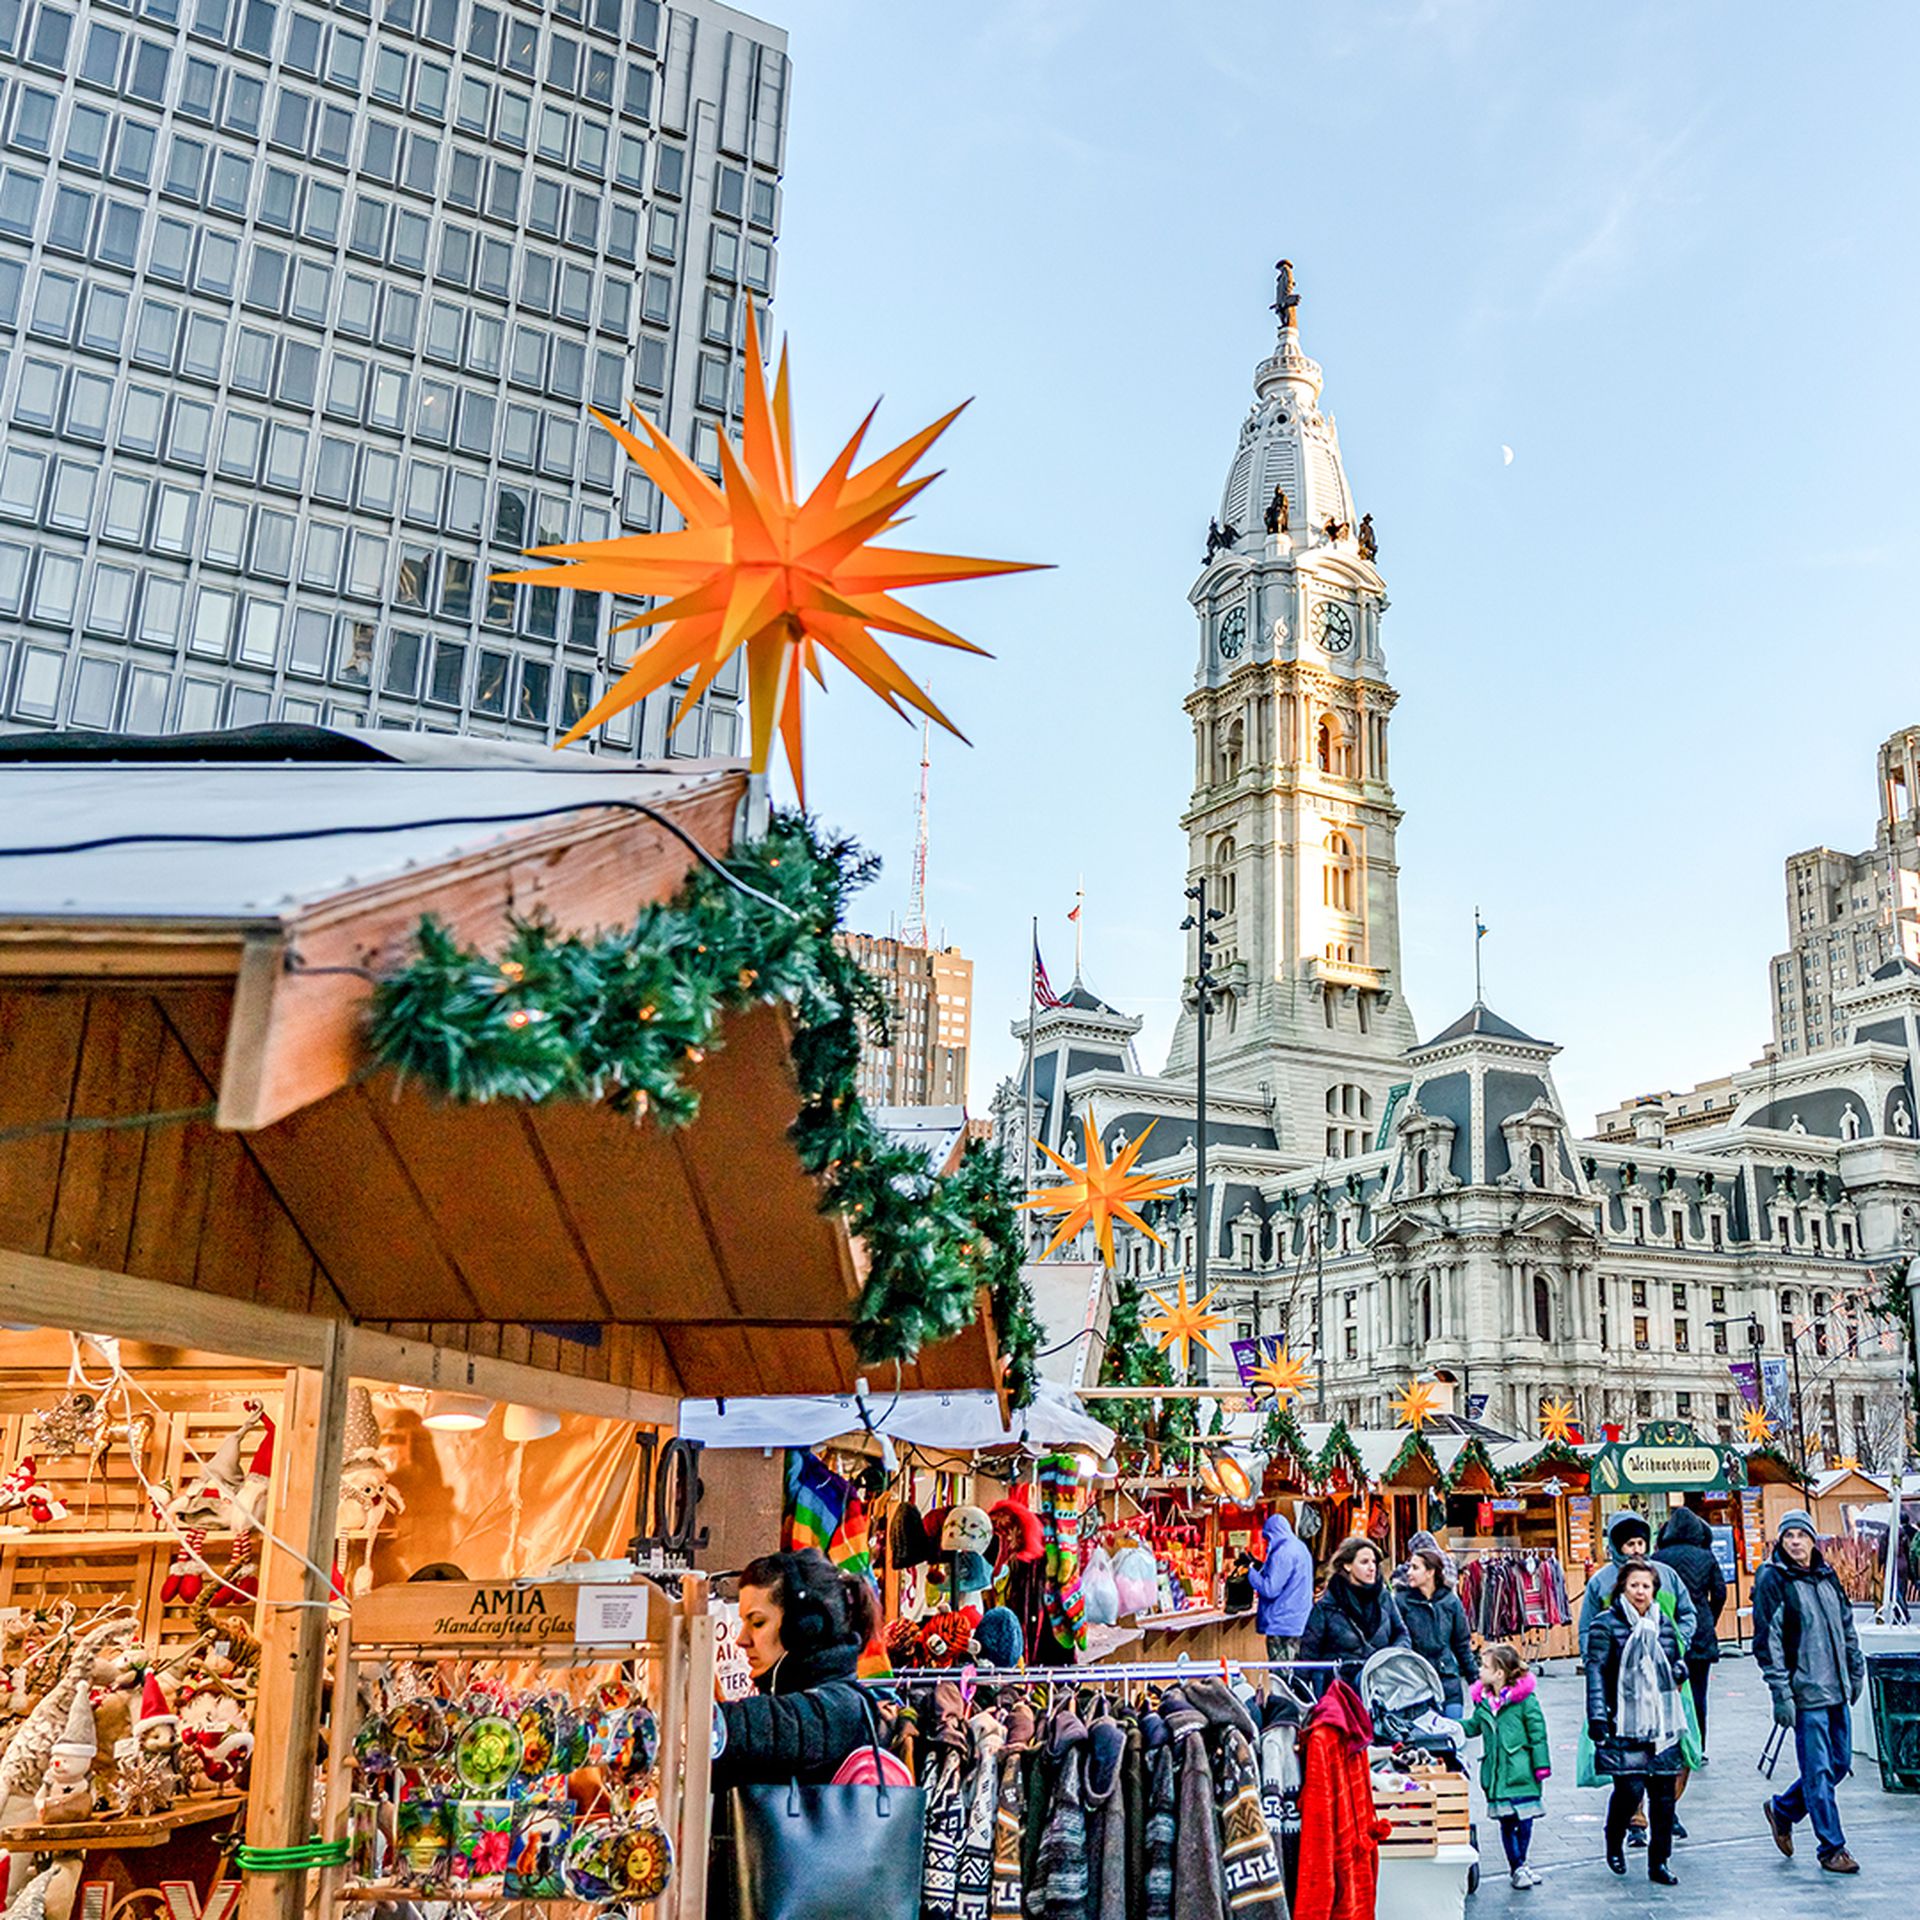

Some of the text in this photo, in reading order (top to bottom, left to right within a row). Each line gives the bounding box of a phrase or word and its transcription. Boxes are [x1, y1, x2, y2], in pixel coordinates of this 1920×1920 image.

[468, 1589, 546, 1614] AMIA
[433, 1614, 576, 1639] Handcrafted Glas
